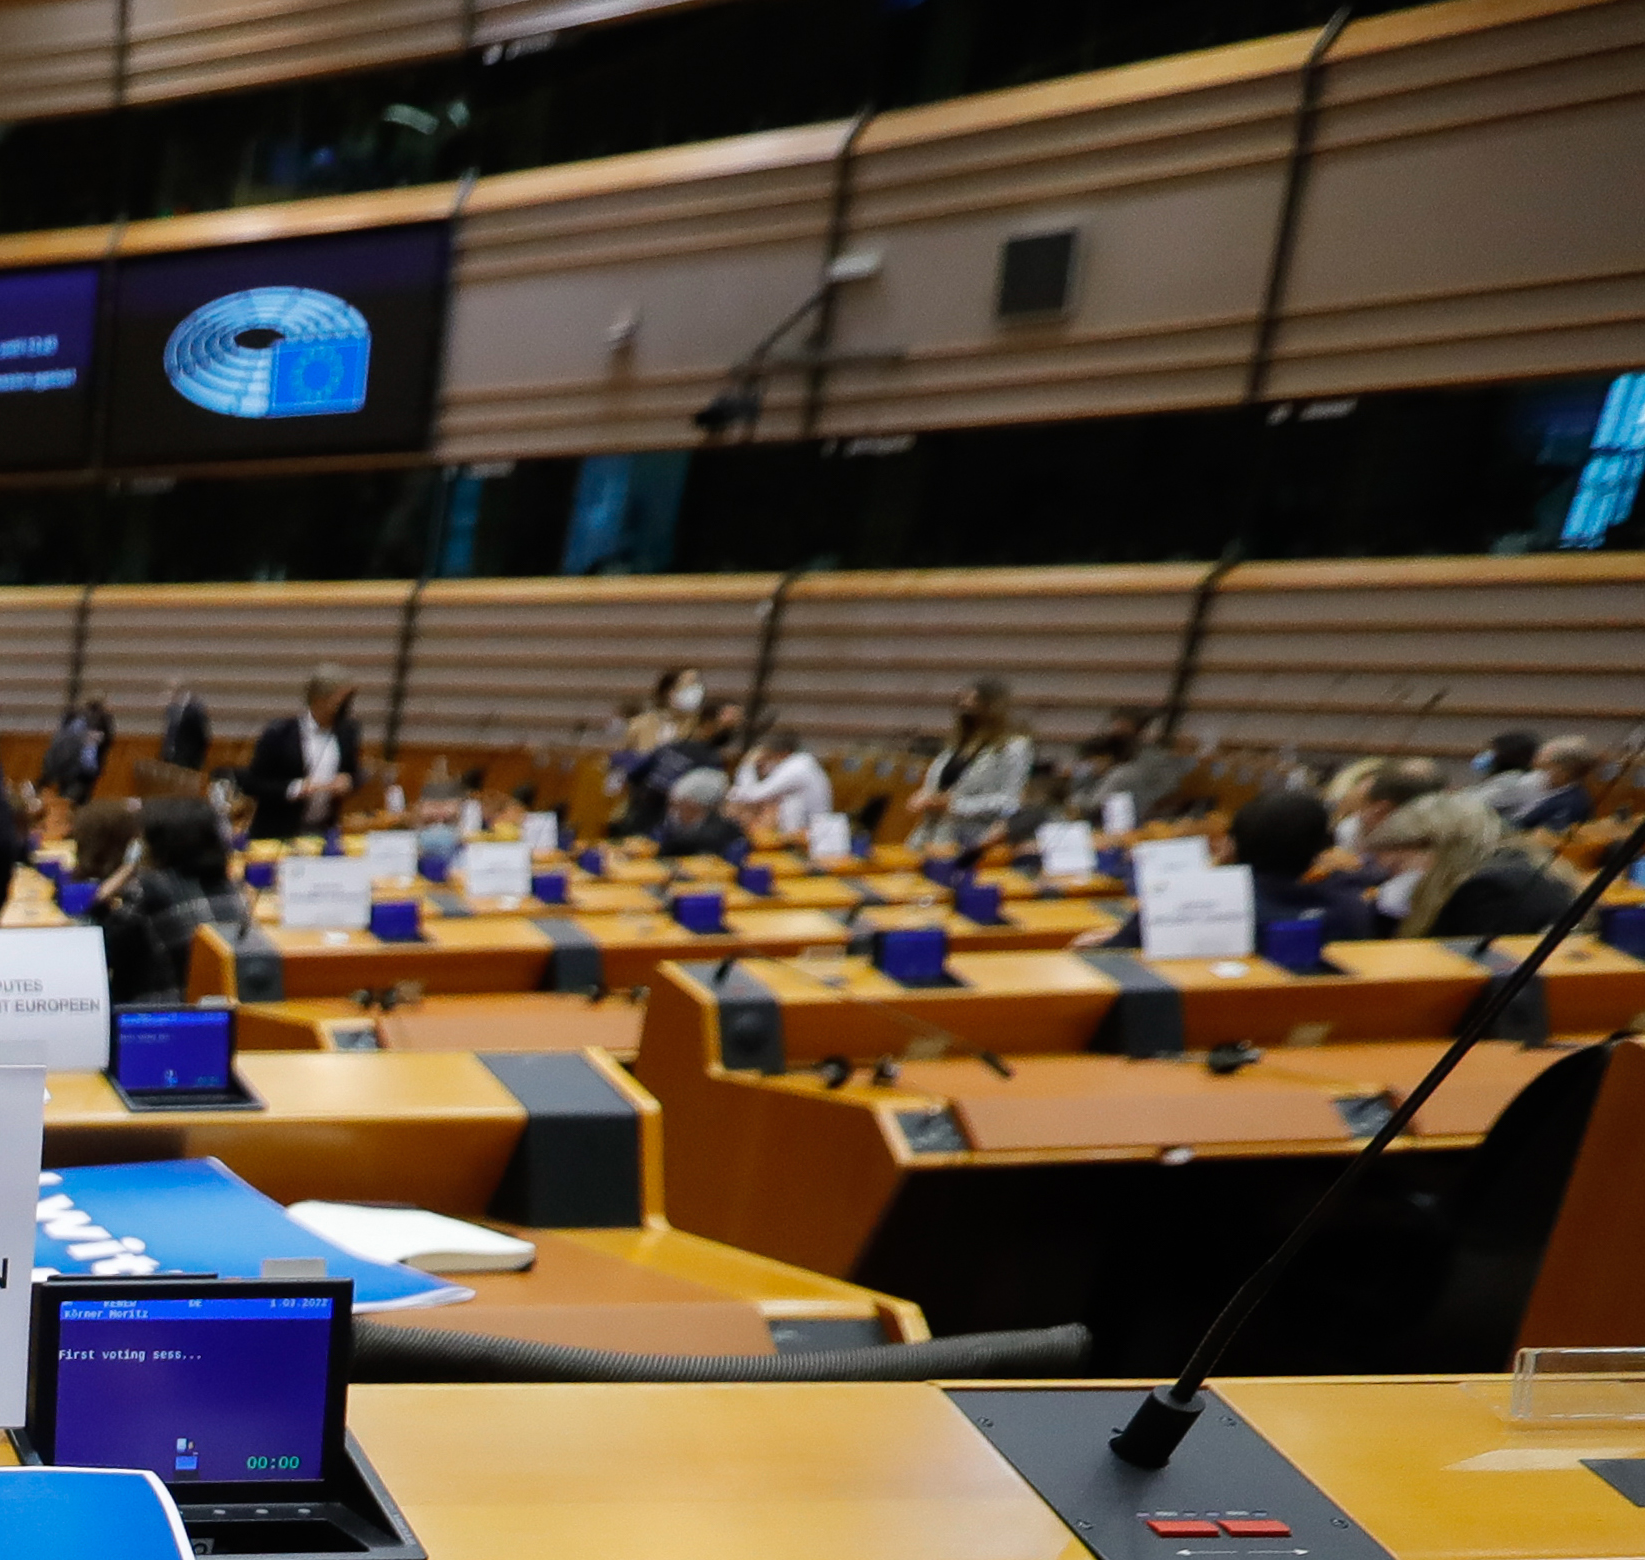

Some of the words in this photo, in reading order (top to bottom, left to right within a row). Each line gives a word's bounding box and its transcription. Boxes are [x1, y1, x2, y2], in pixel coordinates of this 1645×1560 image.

[15, 998, 100, 1013] EUROPEEN
[58, 1348, 95, 1361] First
[102, 1349, 146, 1363] voting
[152, 1350, 202, 1360] sess...
[246, 1456, 300, 1470] 00:00
